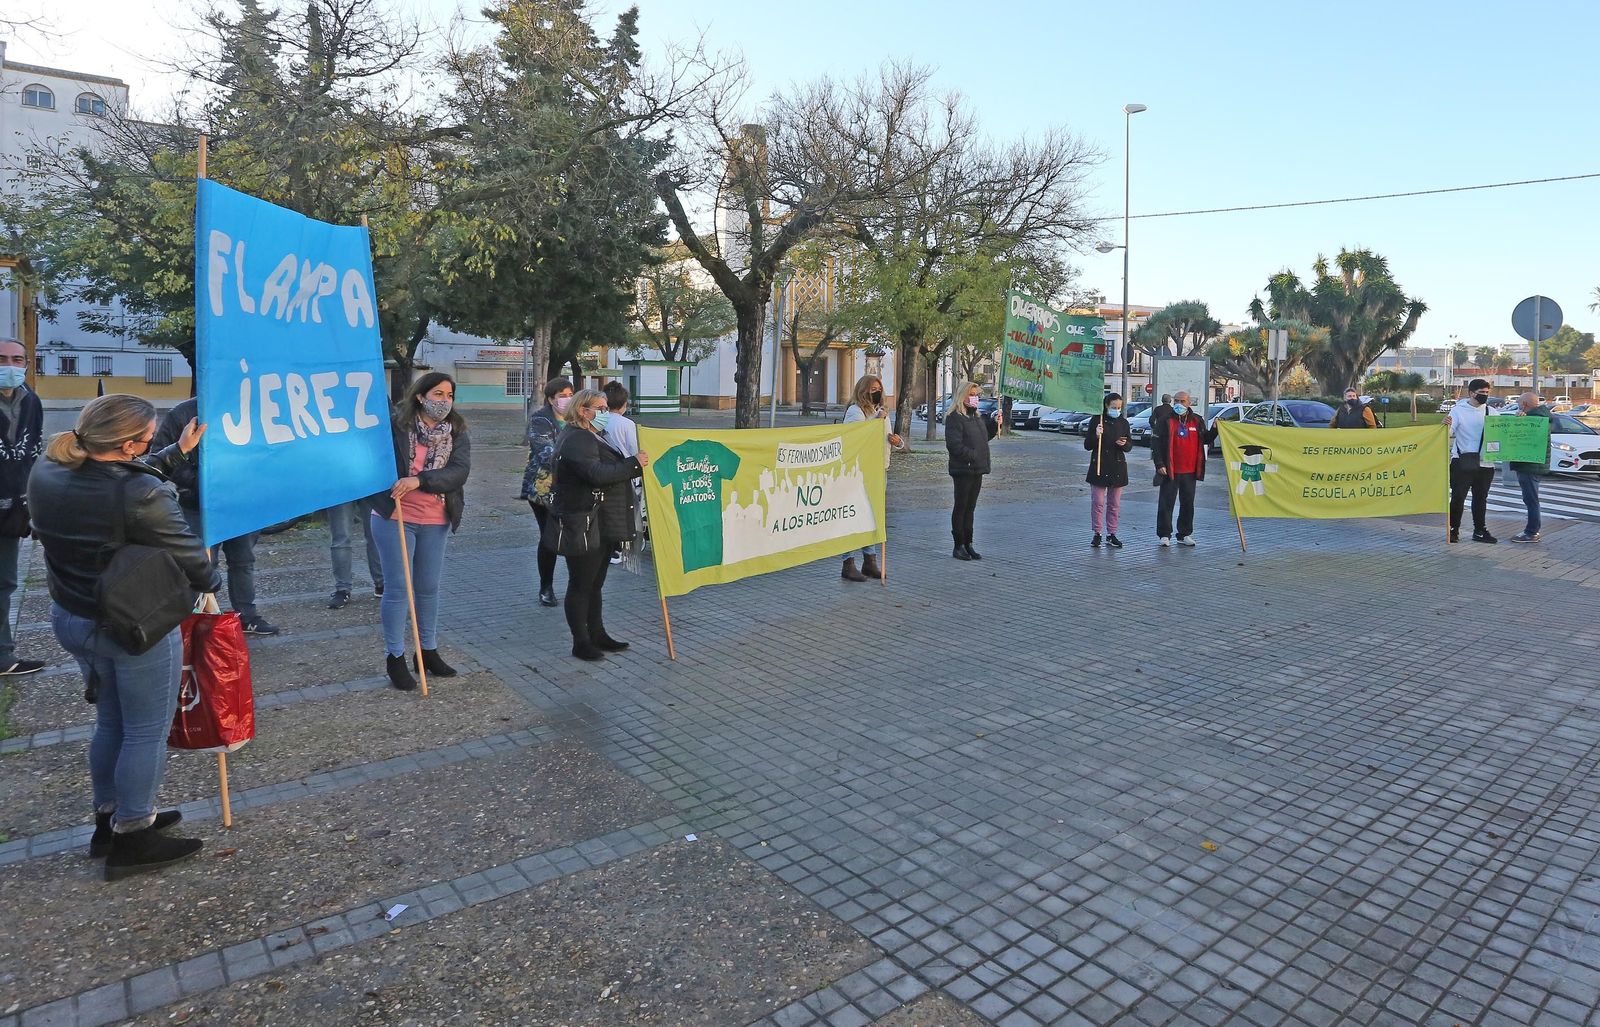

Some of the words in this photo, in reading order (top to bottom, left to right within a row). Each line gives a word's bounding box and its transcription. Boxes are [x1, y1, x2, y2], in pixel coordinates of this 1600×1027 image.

[208, 229, 375, 329] FLAMPA
[788, 449, 818, 464] FERNANDO
[819, 441, 842, 461] SAVATER
[1302, 446, 1320, 455] IES
[1322, 446, 1373, 456] FERNANDO
[1376, 443, 1418, 455] SAVATER
[1310, 472, 1325, 481] EN
[1326, 472, 1372, 482] DEFENSA
[1376, 471, 1388, 481] DE
[1392, 468, 1406, 479] LA
[796, 485, 823, 508] NO
[1302, 486, 1356, 499] ESCUELA
[1360, 483, 1412, 497] PÚBLICA
[772, 519, 780, 533] A
[782, 515, 804, 532] LOS
[805, 504, 857, 526] RECORTES
